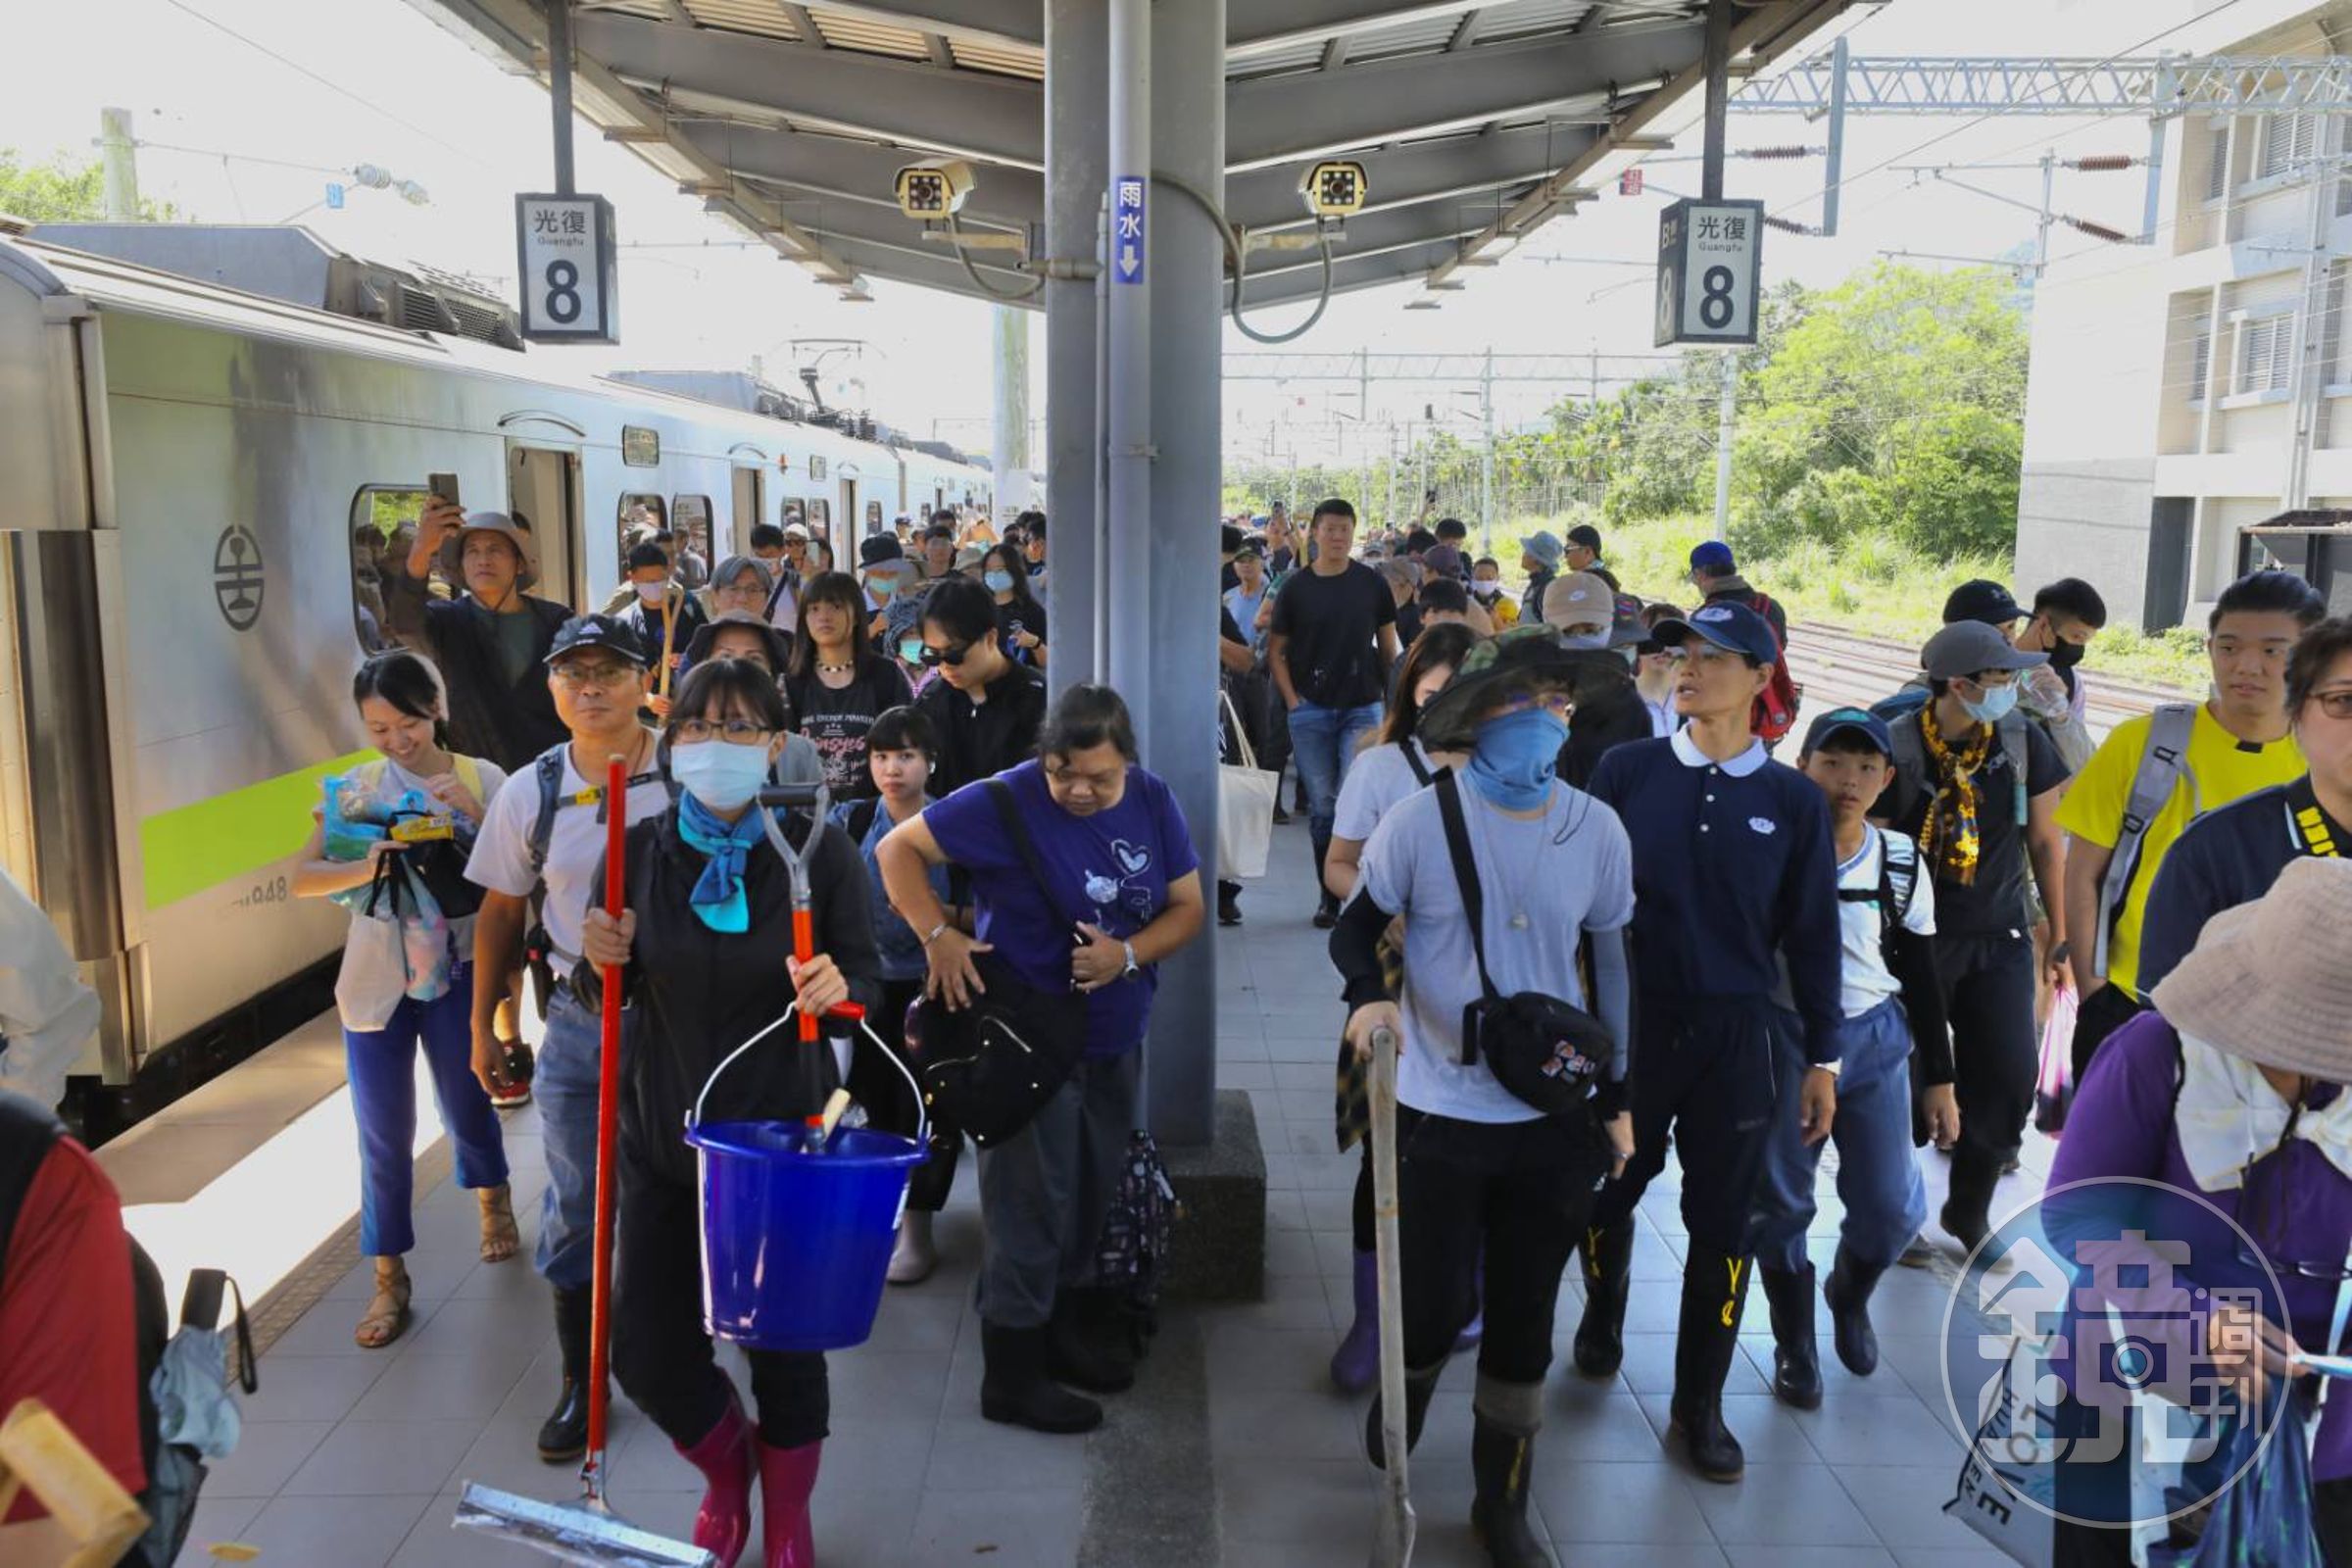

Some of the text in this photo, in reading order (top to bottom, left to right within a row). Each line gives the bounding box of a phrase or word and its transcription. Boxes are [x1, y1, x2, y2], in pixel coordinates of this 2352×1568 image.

[534, 209, 586, 234] 光復
[1119, 181, 1141, 238] 雨水
[1697, 216, 1746, 240] 光復
[1698, 244, 1742, 253] Guangfu
[545, 260, 582, 324] 8
[1699, 265, 1735, 329] 8
